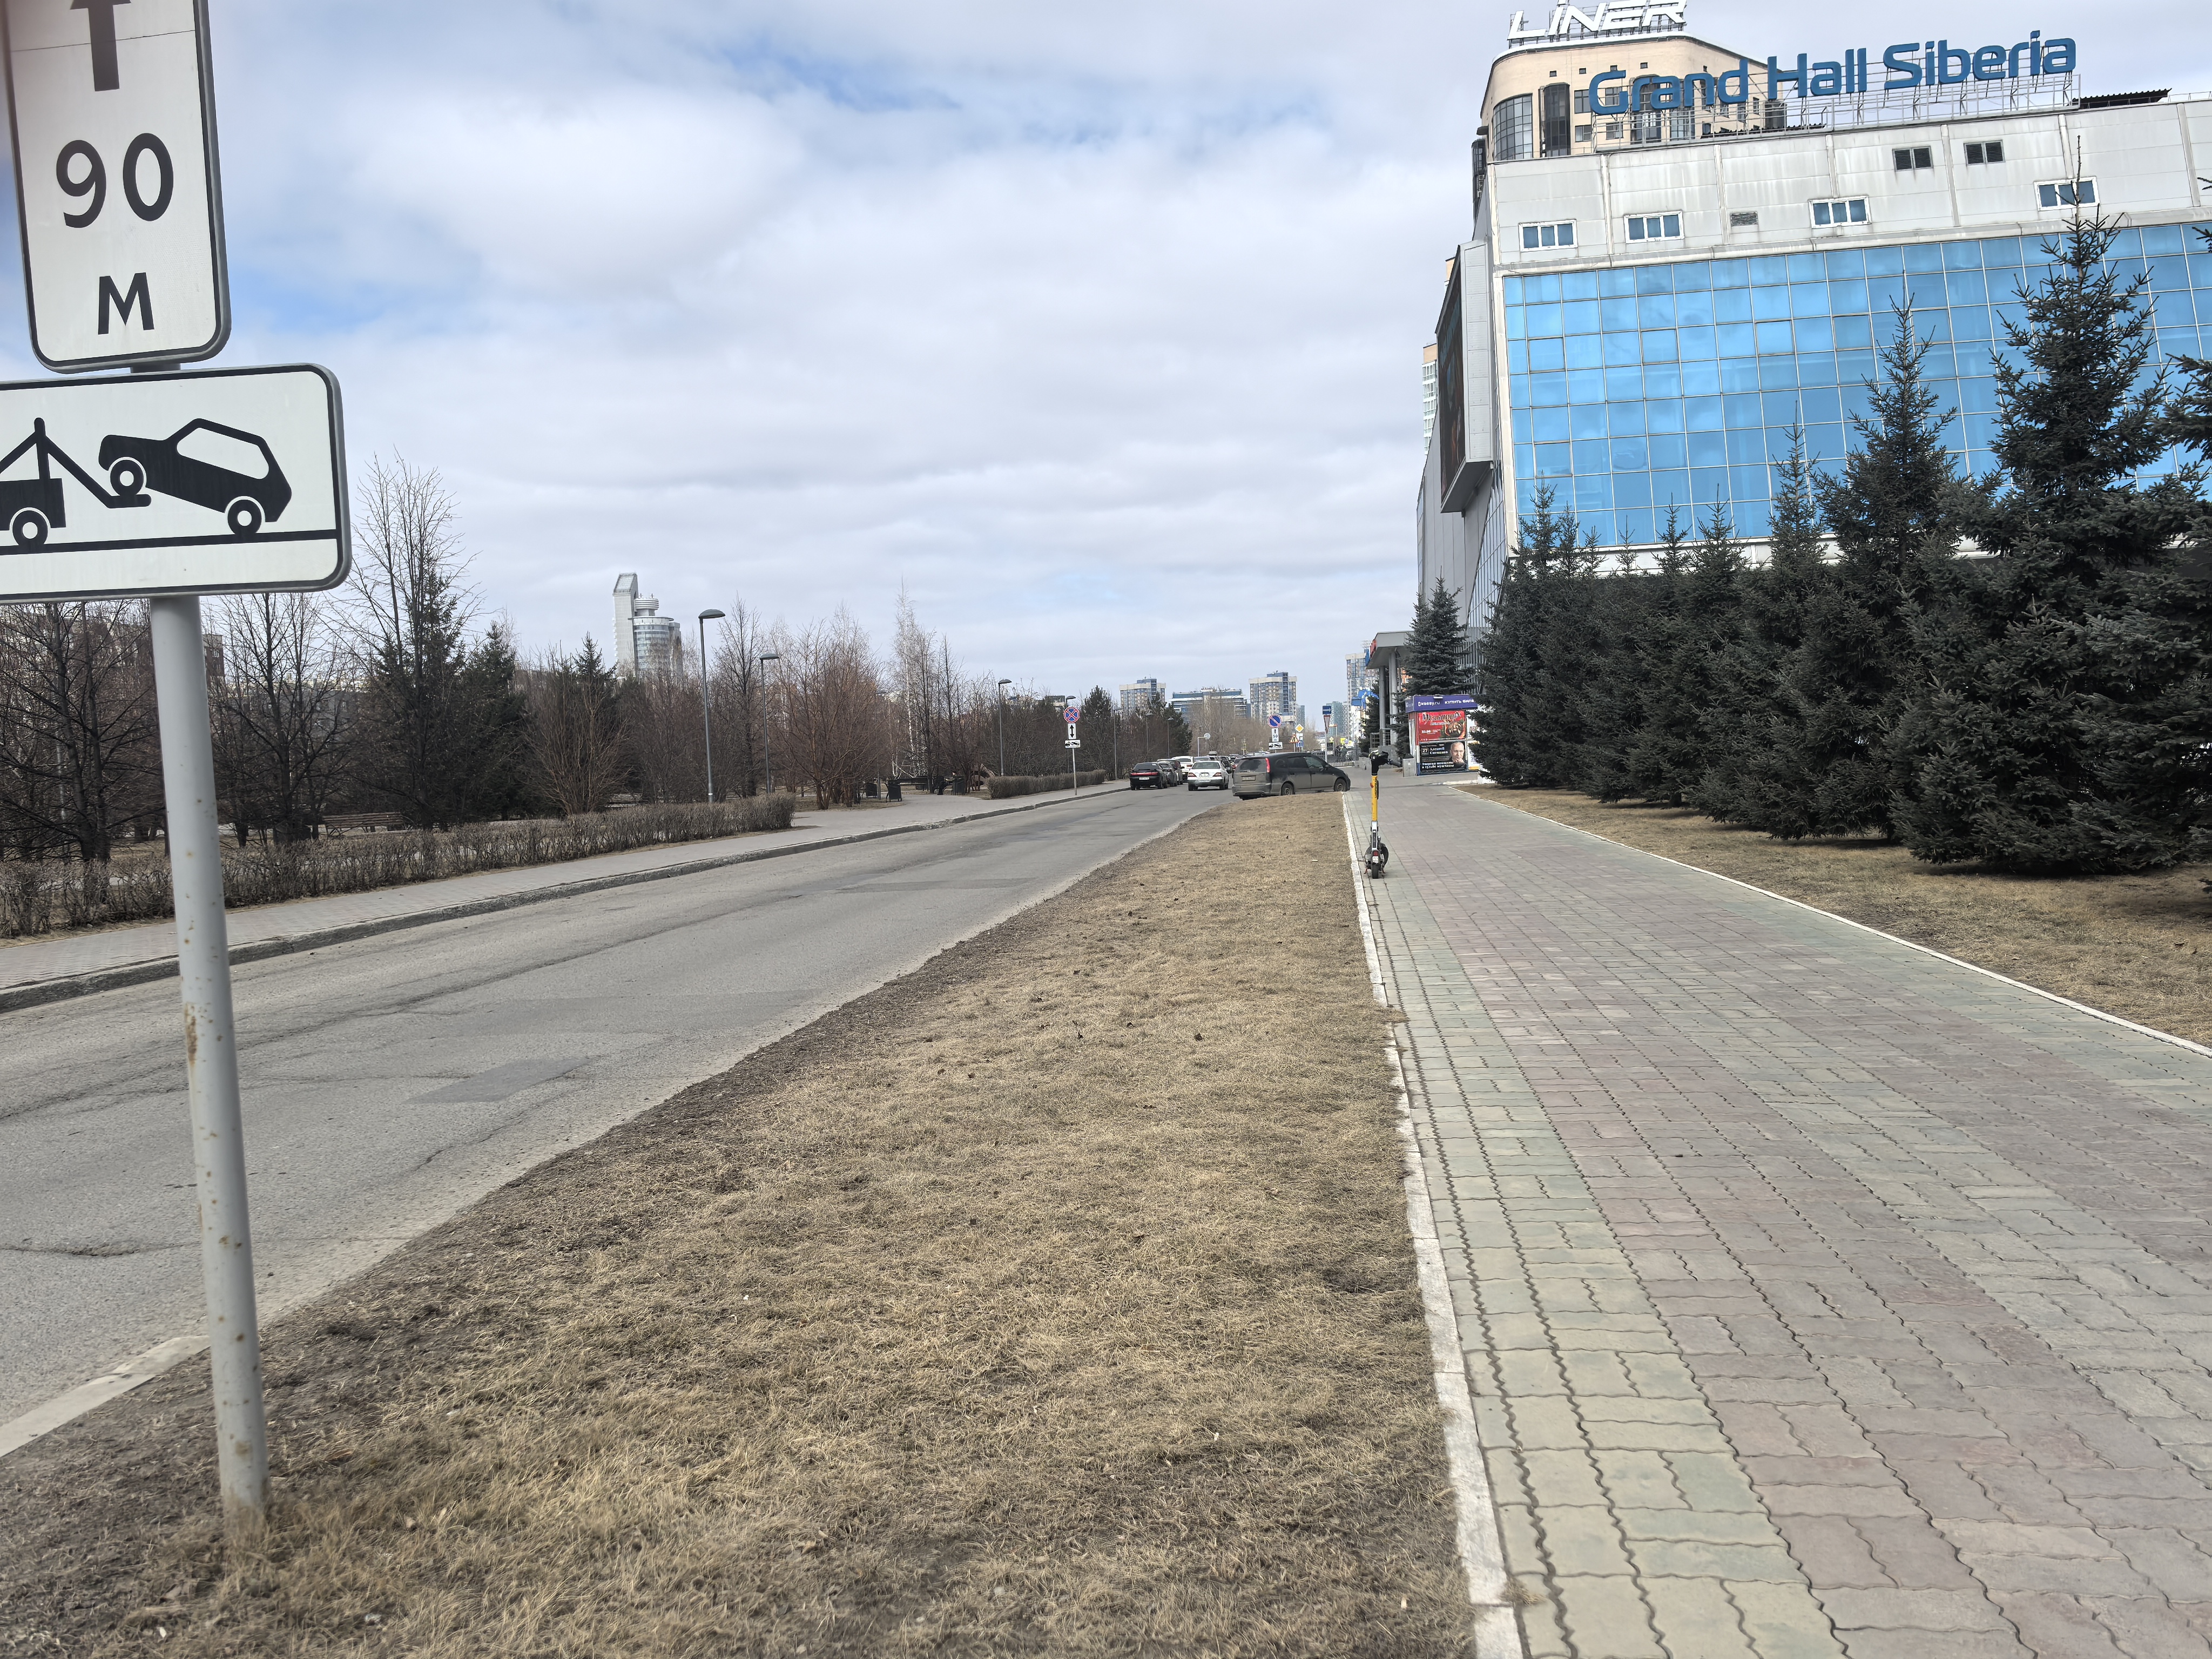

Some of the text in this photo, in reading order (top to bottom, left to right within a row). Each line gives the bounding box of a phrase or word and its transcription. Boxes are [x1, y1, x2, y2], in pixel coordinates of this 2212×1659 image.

[1588, 30, 2076, 115] Grand Hall Siberia
[56, 133, 173, 228] 90
